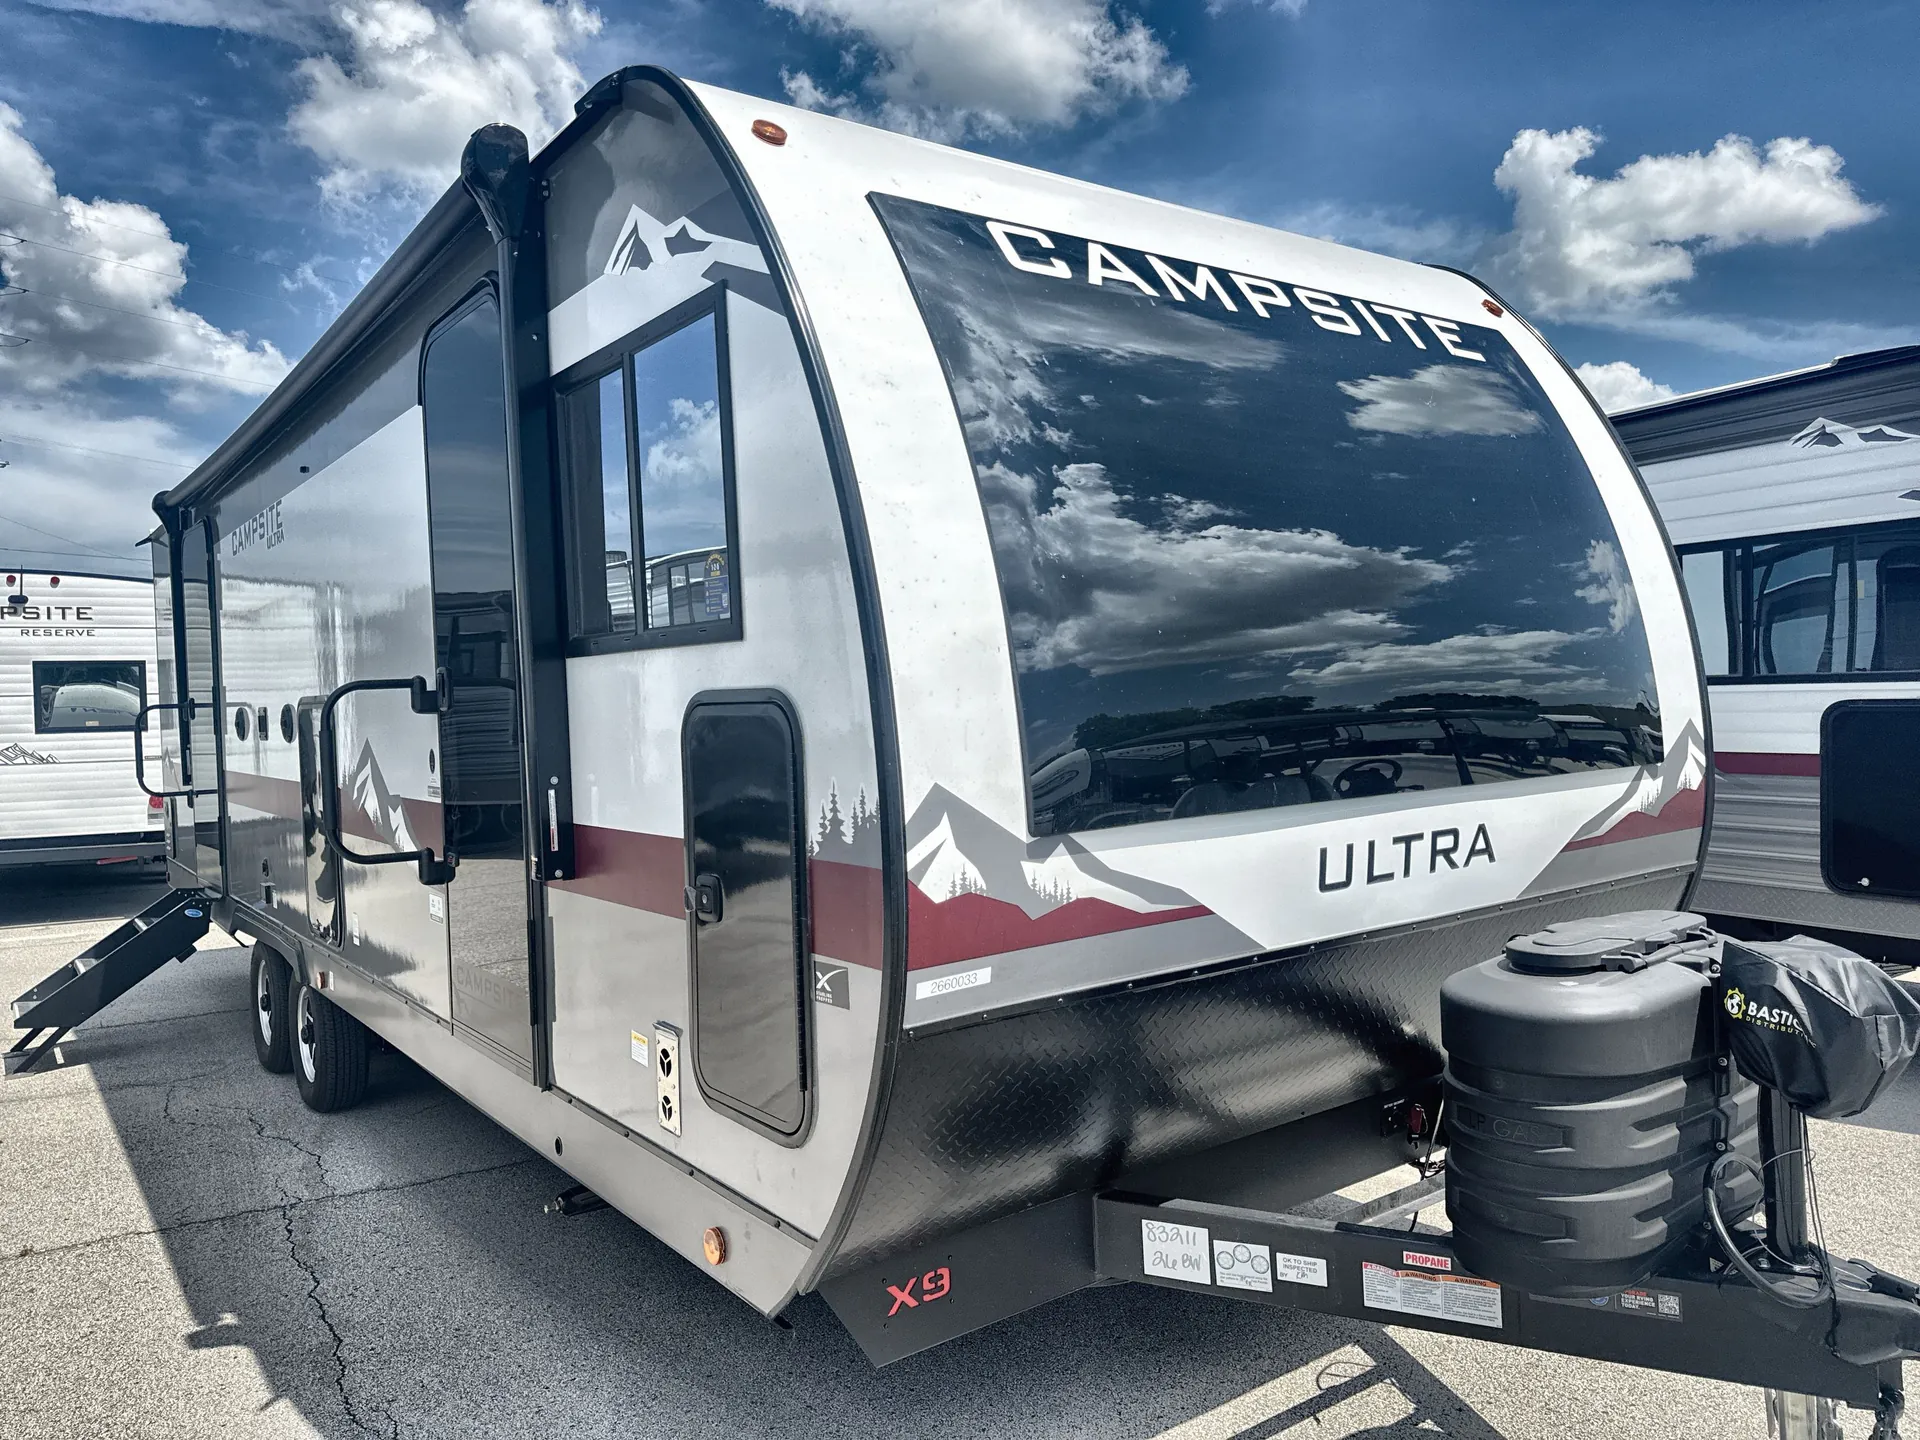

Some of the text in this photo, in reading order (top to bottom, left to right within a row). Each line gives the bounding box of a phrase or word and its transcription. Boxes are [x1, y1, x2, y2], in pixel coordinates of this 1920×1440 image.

[985, 220, 1487, 362] CAMPSITE
[231, 499, 283, 556] CAMPSITE
[266, 528, 285, 550] ULTRA
[20, 629, 96, 637] RESERVE
[1318, 823, 1496, 893] ULTRA
[930, 972, 978, 994] 2660033
[1492, 1119, 1541, 1140] GAS
[1282, 1263, 1318, 1274] INSPECTED
[1371, 1264, 1397, 1277] DANGER
[1405, 1253, 1450, 1268] PROPANE
[1409, 1272, 1437, 1281] WARNING
[1459, 1277, 1487, 1287] WARNING
[886, 1267, 951, 1317] X9
